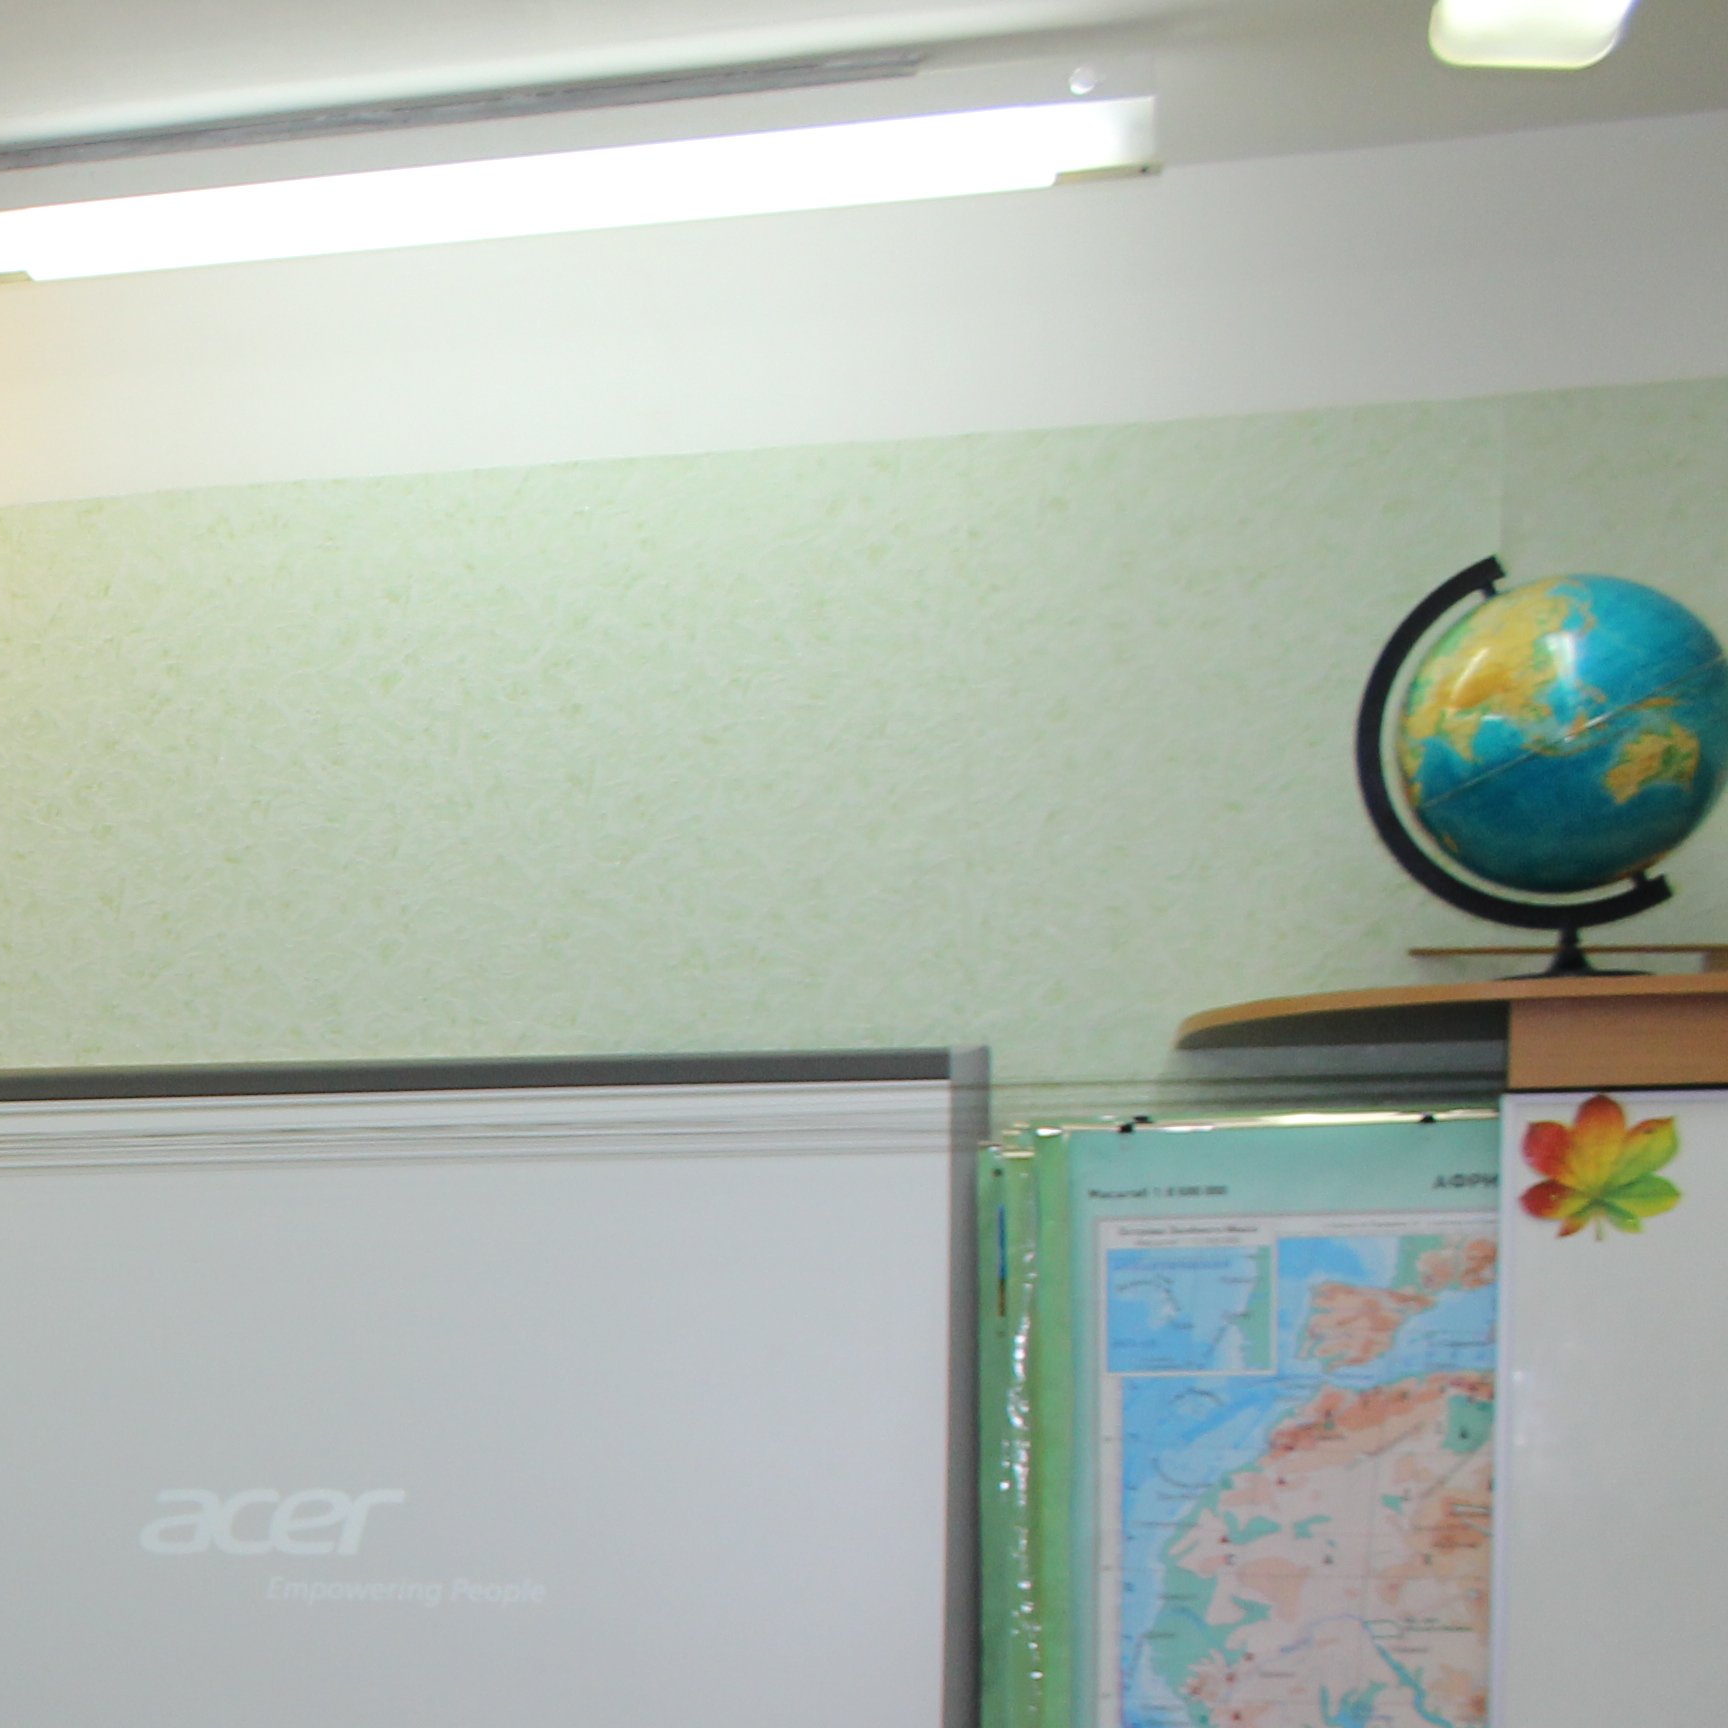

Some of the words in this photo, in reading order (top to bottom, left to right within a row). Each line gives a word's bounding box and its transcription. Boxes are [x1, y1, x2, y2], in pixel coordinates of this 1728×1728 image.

[138, 1487, 406, 1557] acer
[266, 1575, 442, 1609] Empowering
[450, 1577, 547, 1609] People
